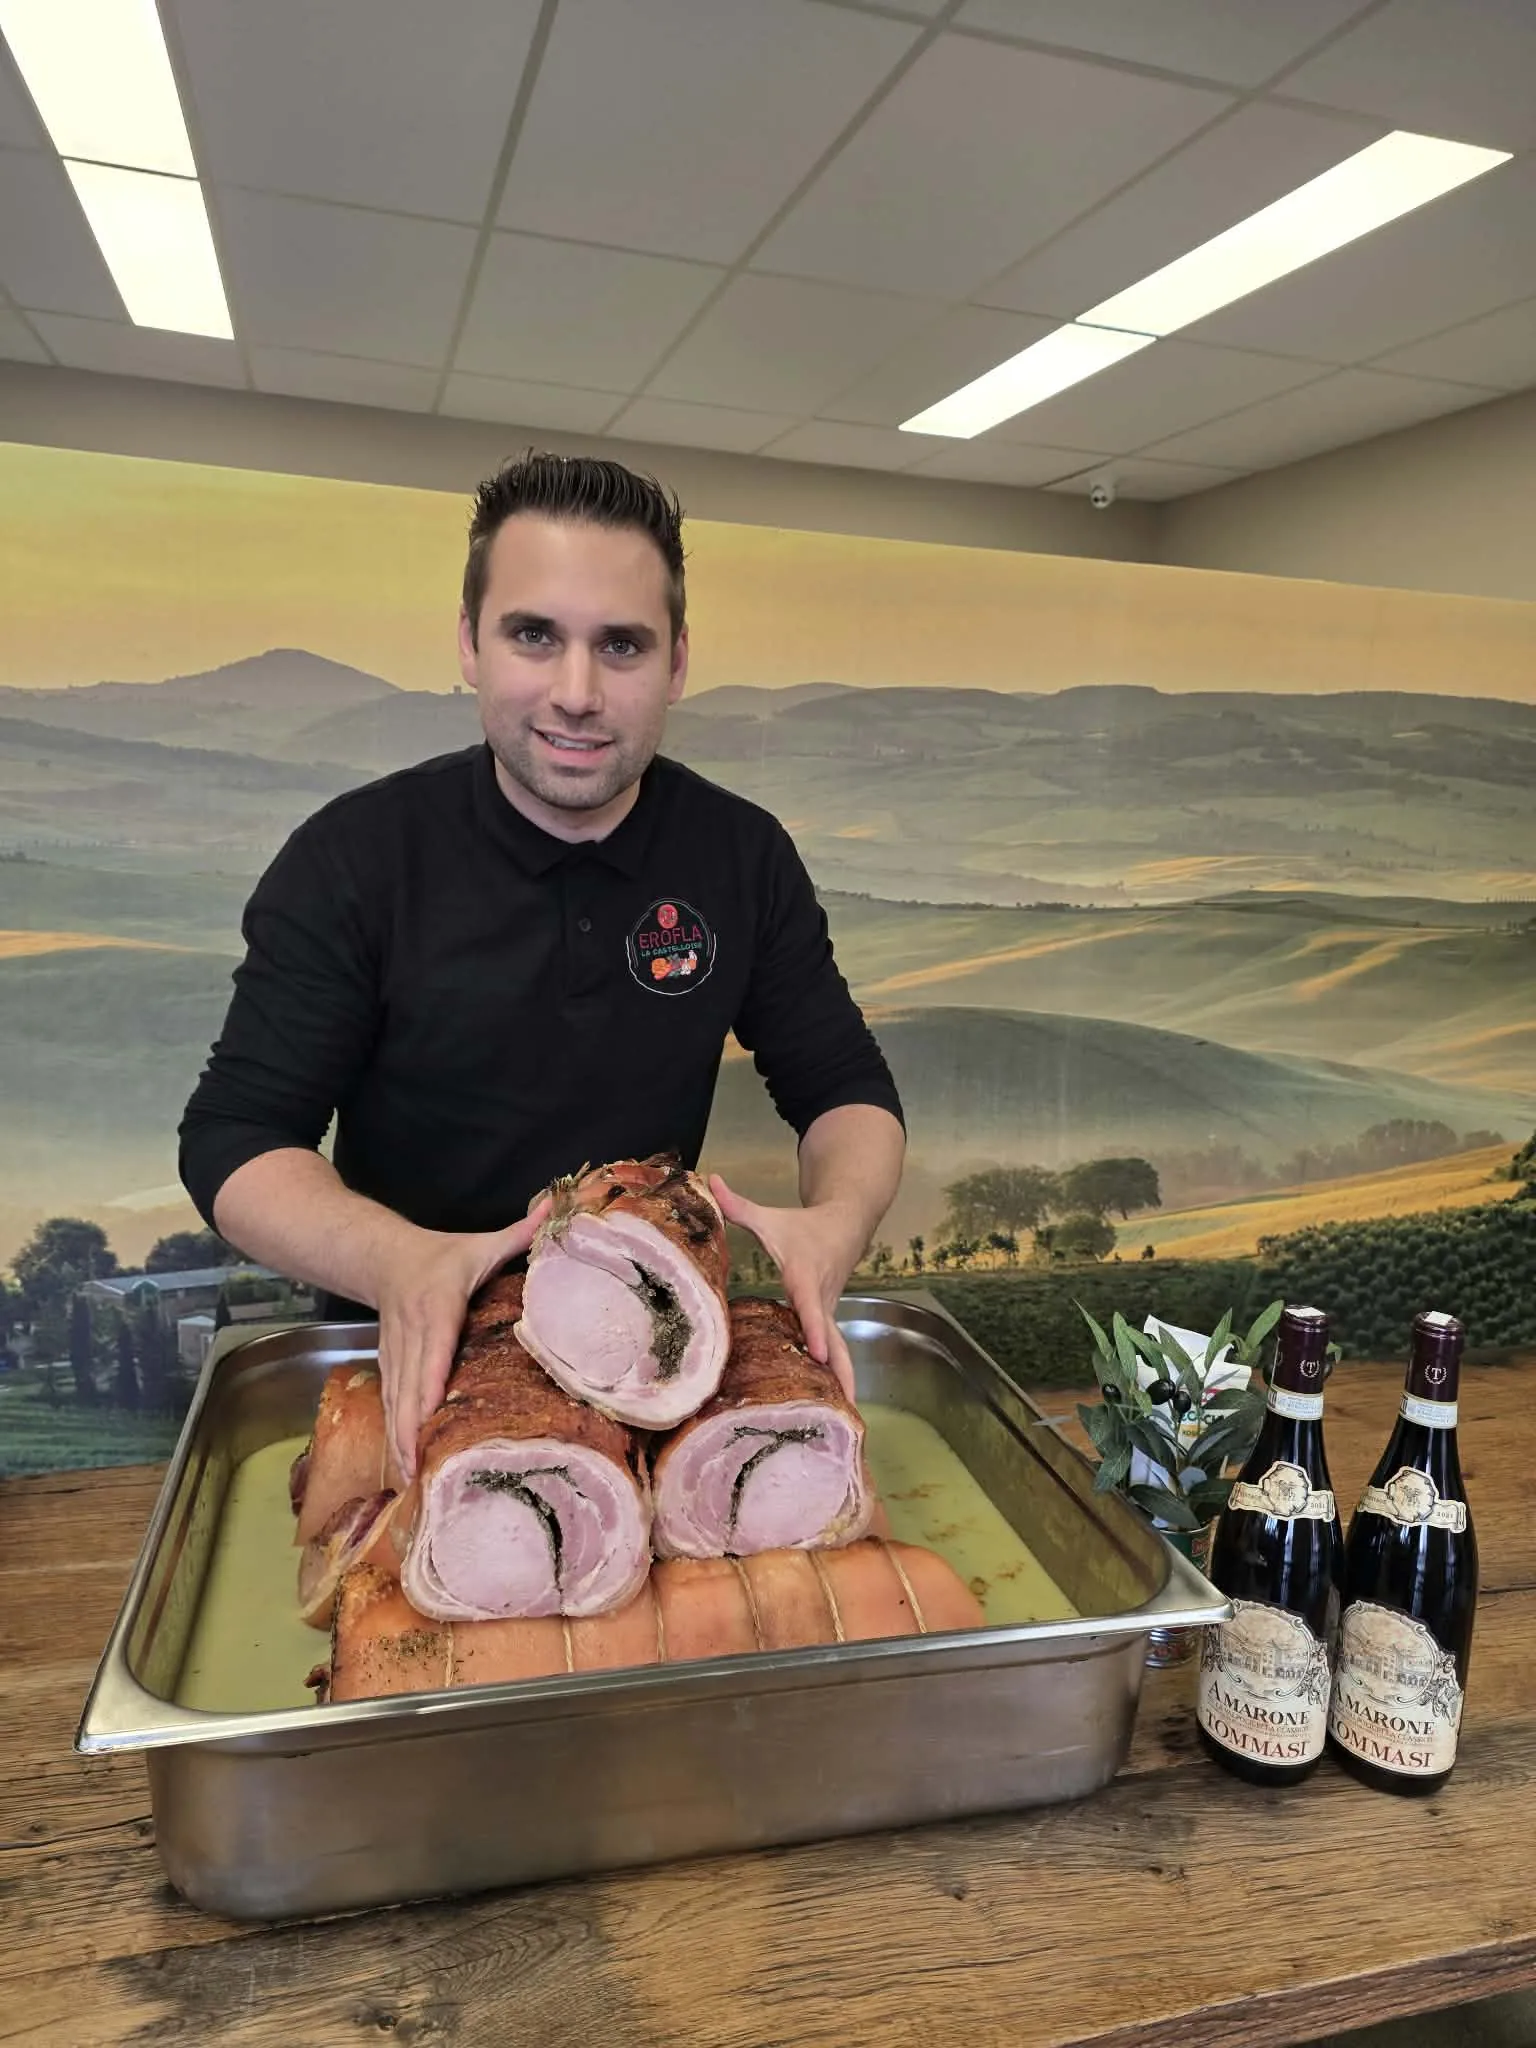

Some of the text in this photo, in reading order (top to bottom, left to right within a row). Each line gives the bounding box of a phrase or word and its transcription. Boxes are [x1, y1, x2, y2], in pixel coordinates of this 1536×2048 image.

[639, 925, 703, 949] EROFLA
[1207, 1679, 1311, 1726] AMARONE
[1206, 1708, 1311, 1758] TOMMASI
